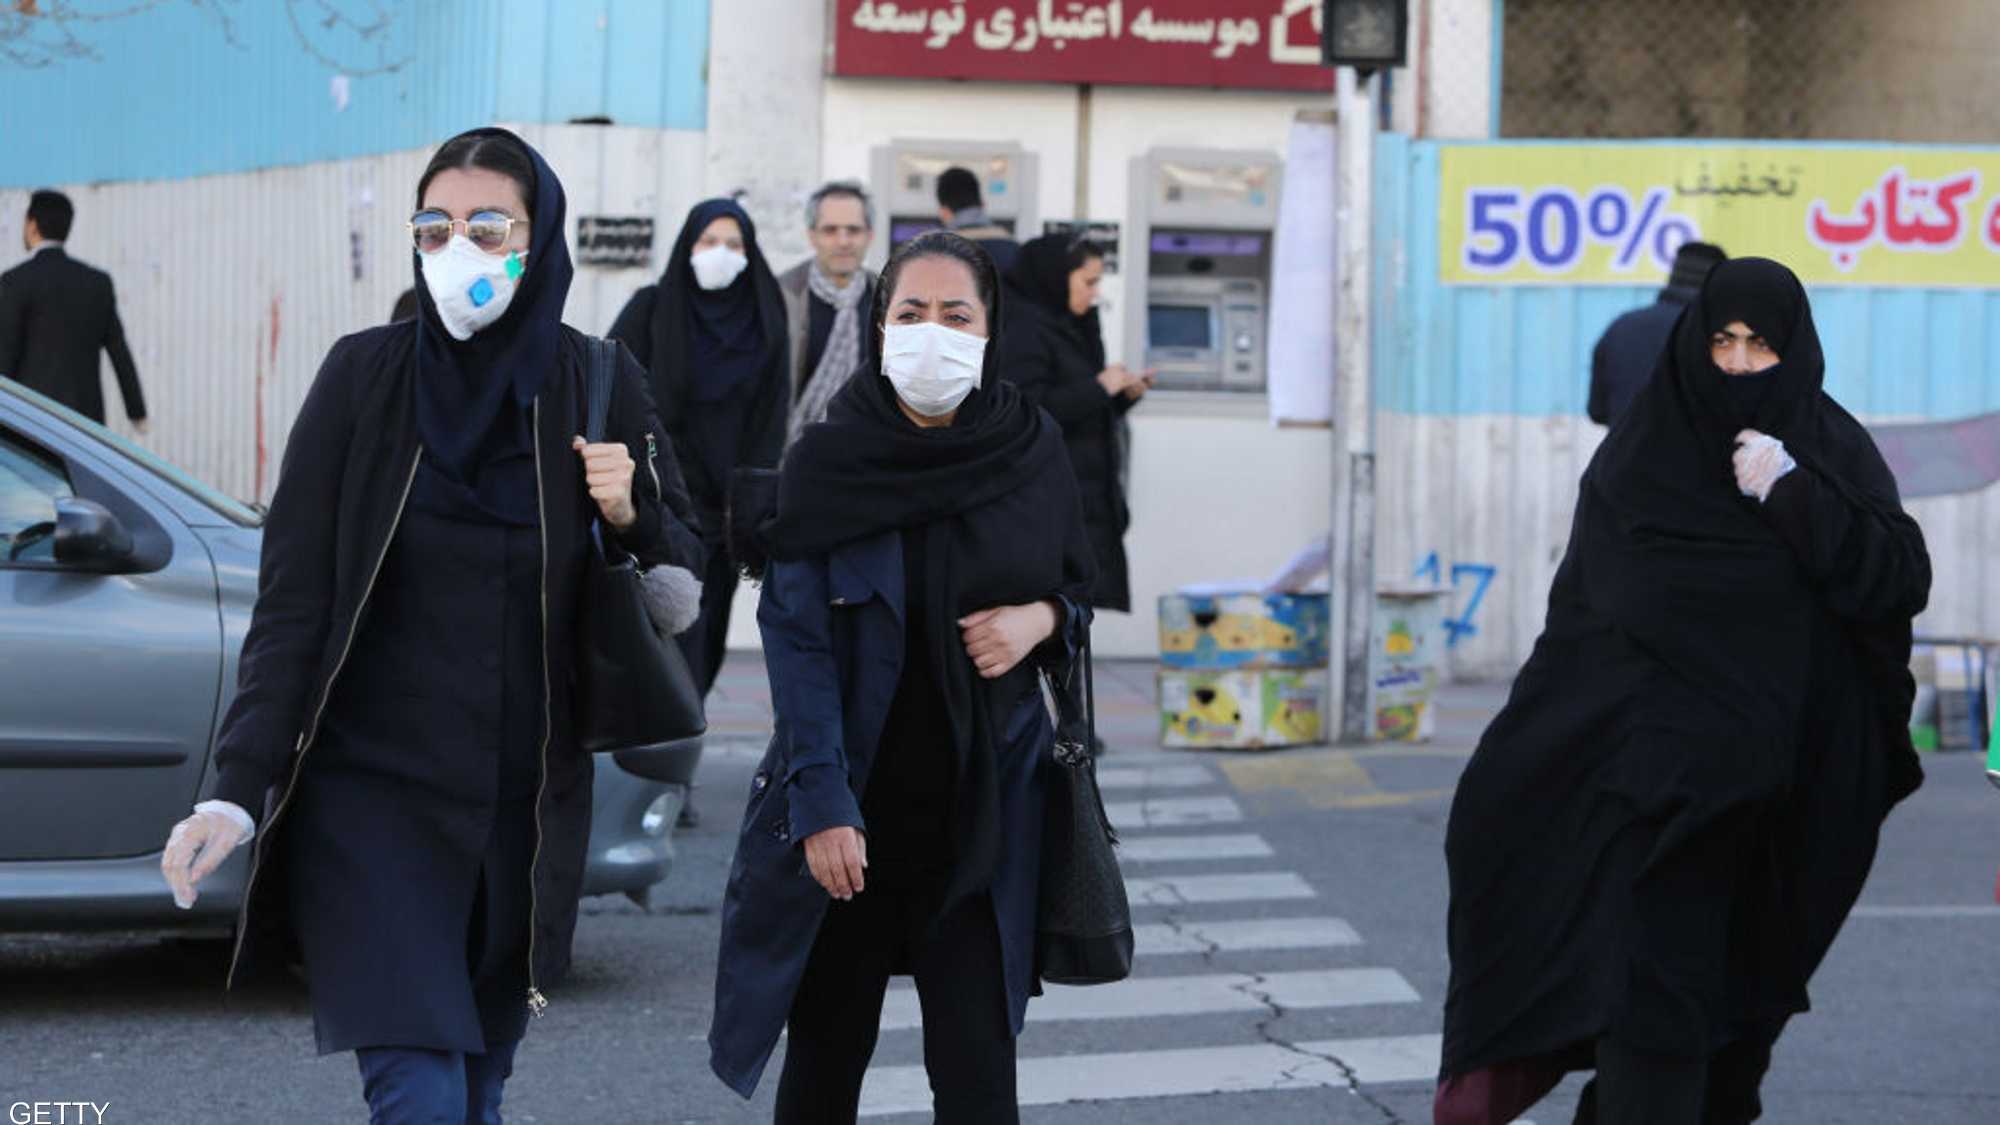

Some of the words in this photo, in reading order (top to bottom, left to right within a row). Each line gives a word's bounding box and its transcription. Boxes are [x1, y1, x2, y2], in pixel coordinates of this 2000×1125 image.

[852, 0, 966, 49] توسعه
[973, 0, 1122, 51] اعتباری
[1130, 8, 1260, 58] موسسه
[1674, 161, 1804, 208] تخفیف
[1468, 192, 1697, 266] 50%
[1812, 174, 1974, 265] کتاب
